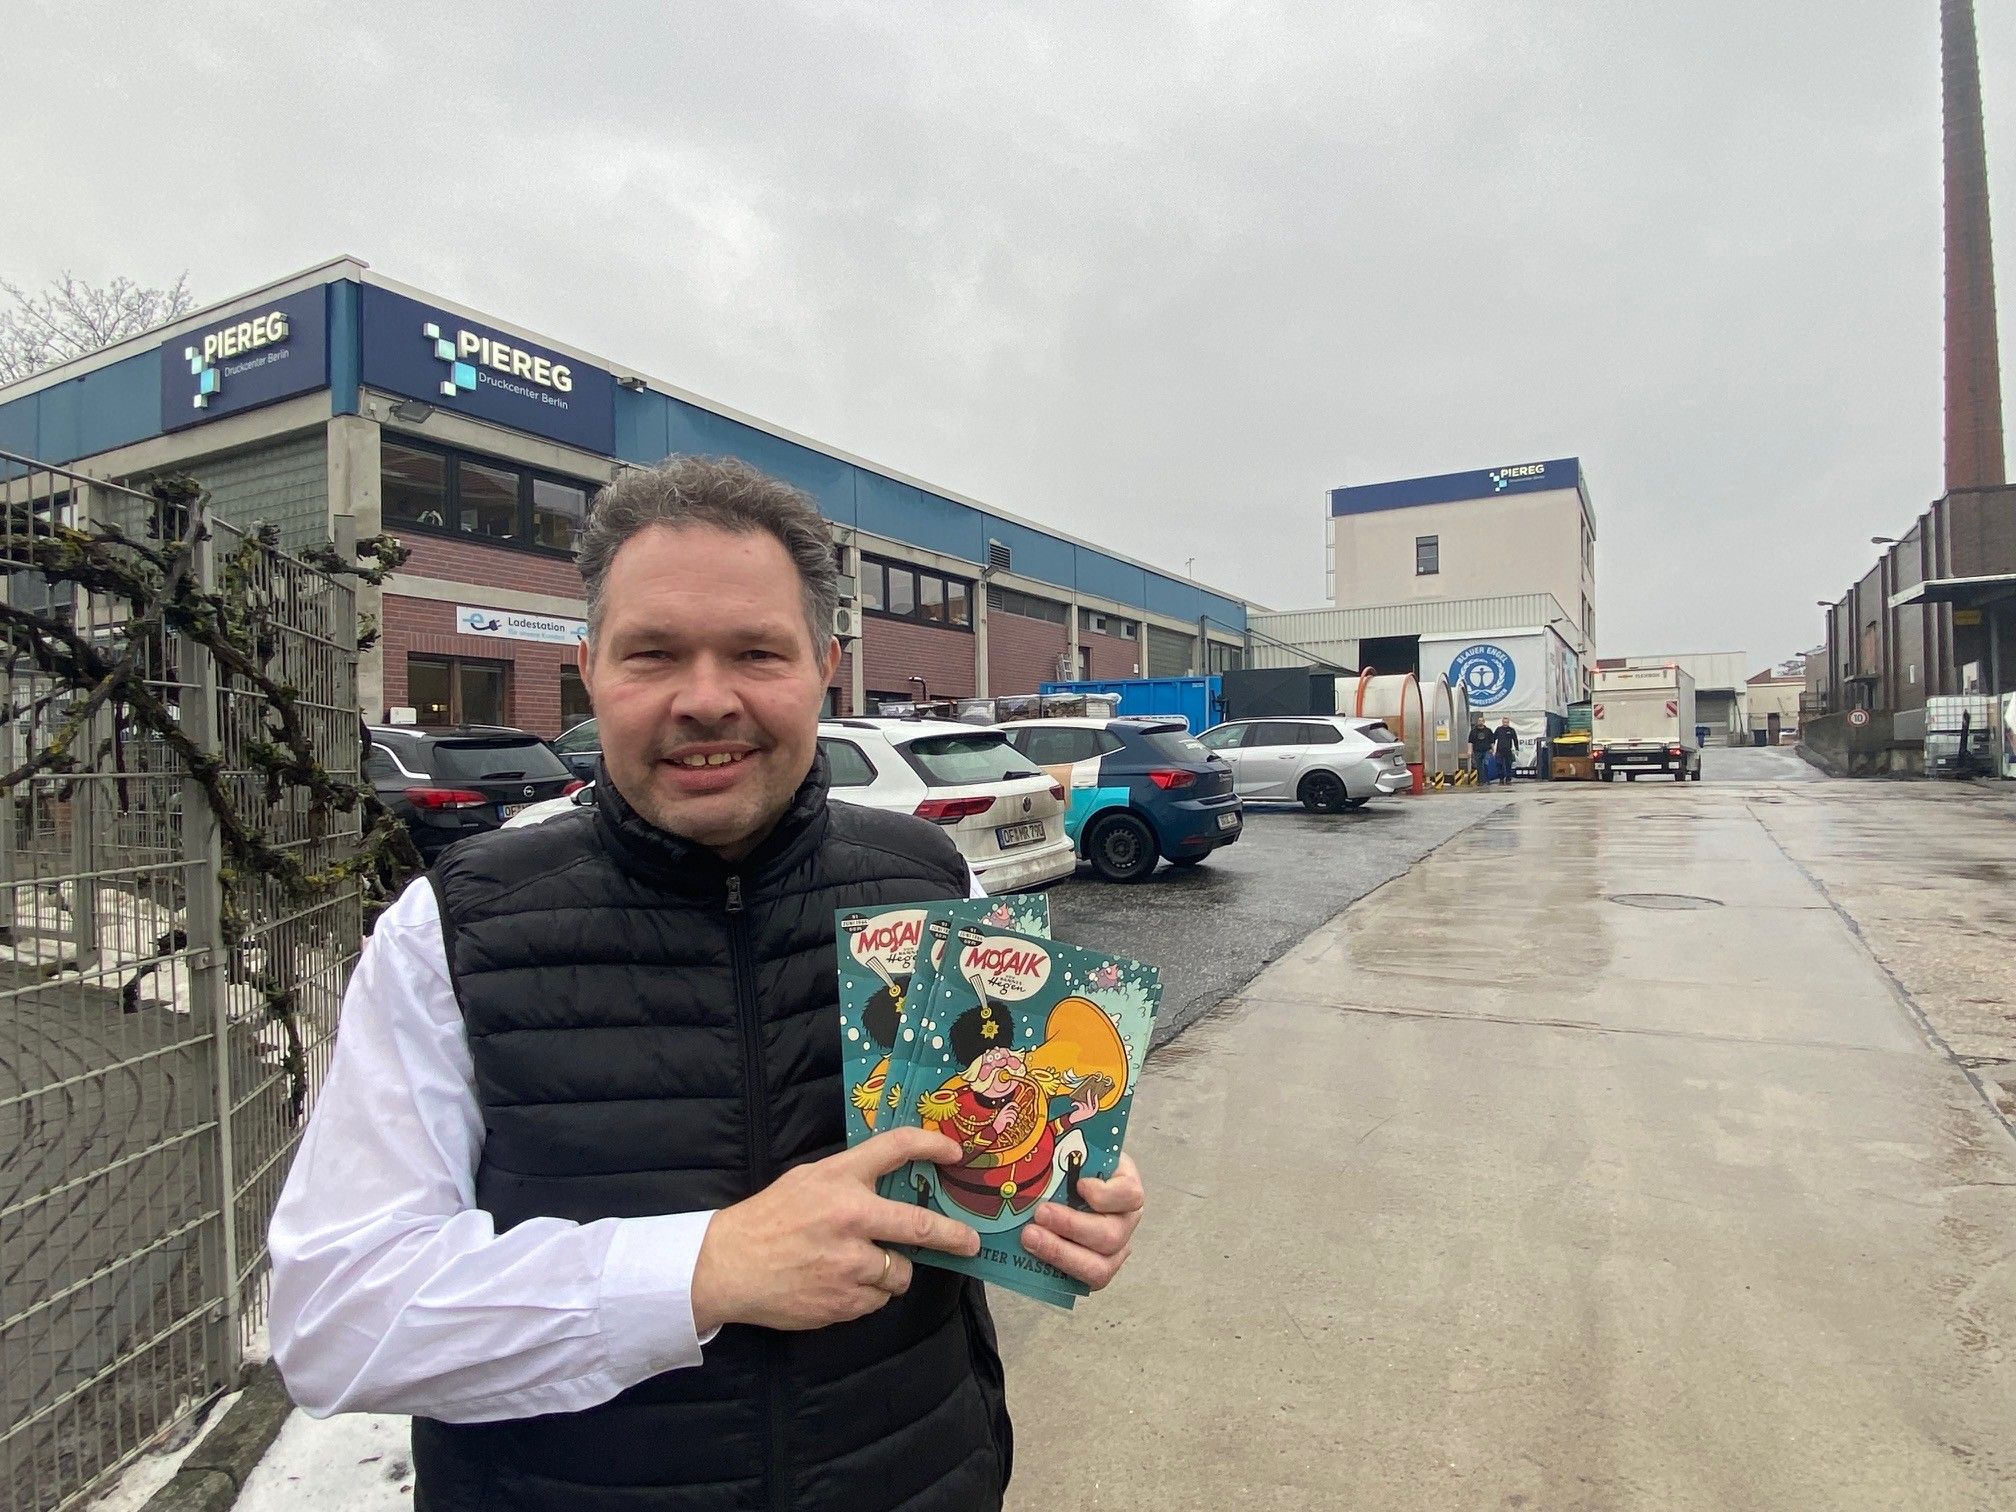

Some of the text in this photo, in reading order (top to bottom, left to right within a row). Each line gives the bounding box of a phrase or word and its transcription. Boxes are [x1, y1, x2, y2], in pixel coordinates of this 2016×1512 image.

[204, 311, 289, 363] PIEREG
[224, 348, 290, 378] Druckcenter Berlin
[457, 329, 573, 392] PIEREG
[478, 372, 569, 410] Druckcenter Berlin
[1500, 464, 1545, 478] PIEREG
[507, 616, 566, 633] Ladestation
[1456, 646, 1509, 664] BLAUER ENGEL
[1853, 713, 1864, 723] 10
[857, 919, 922, 954] MOSAI
[964, 947, 1048, 977] MOSAIK
[987, 976, 1027, 995] Hegen
[981, 1248, 1008, 1265] TER
